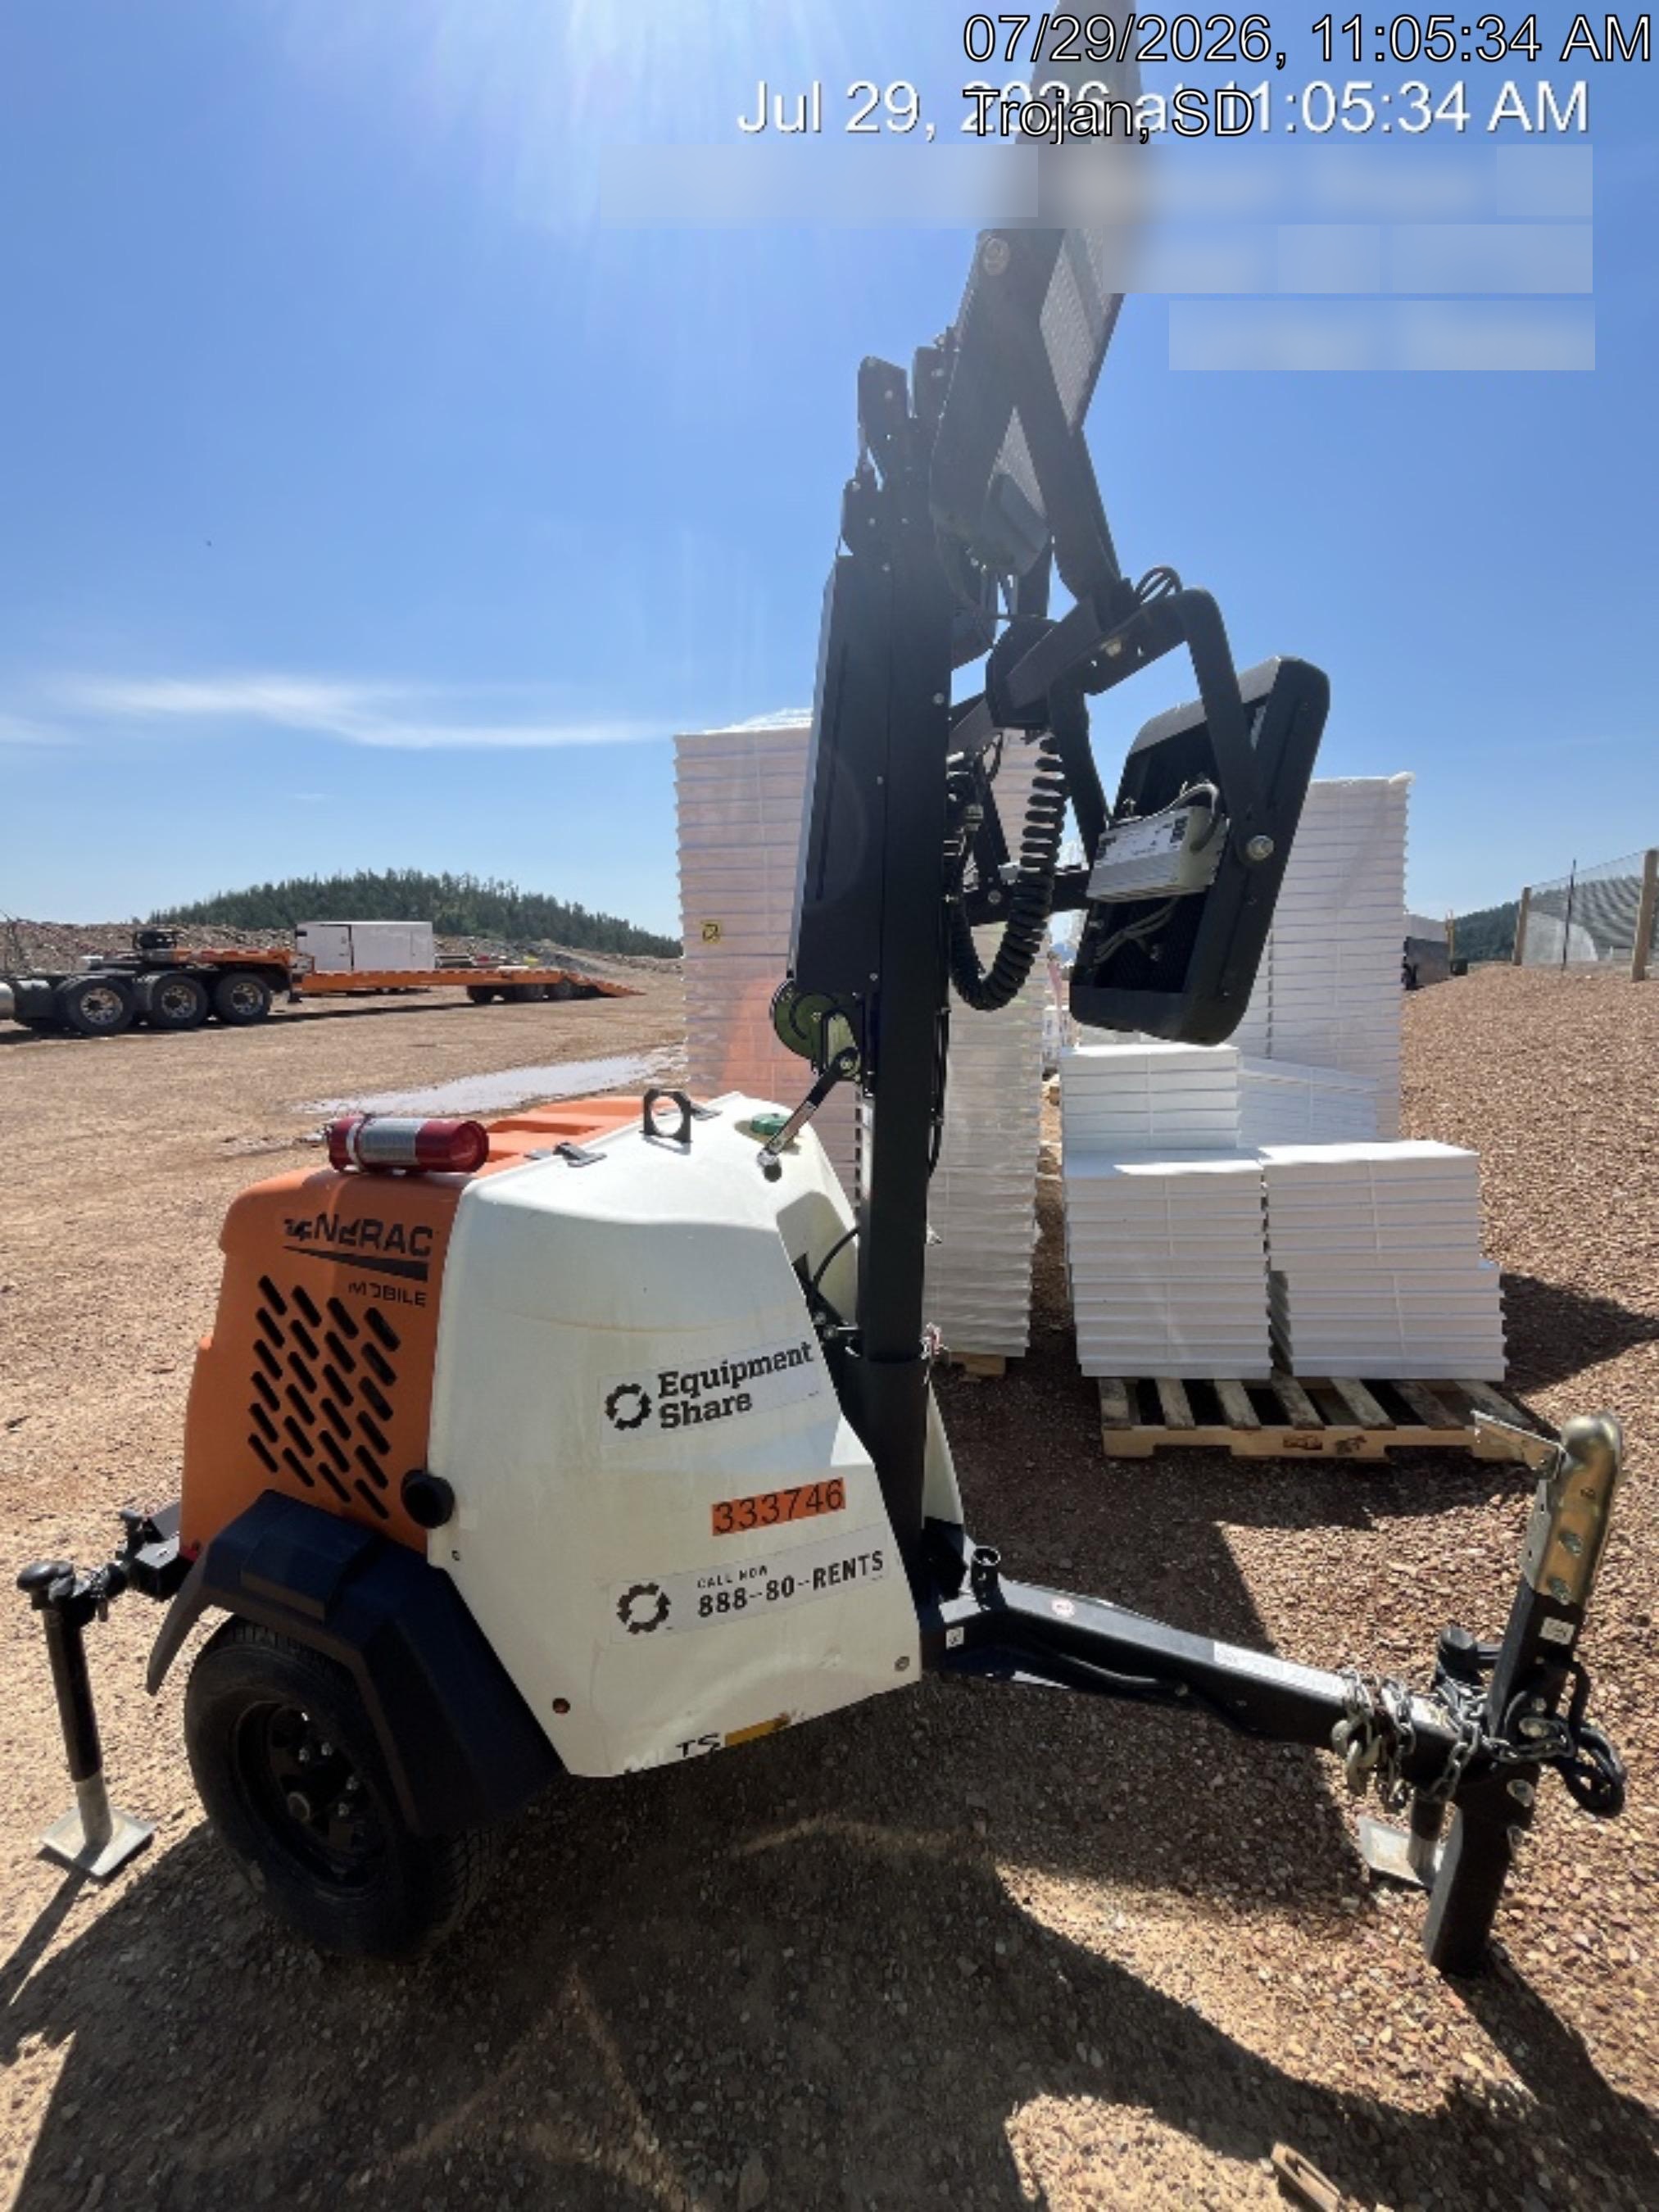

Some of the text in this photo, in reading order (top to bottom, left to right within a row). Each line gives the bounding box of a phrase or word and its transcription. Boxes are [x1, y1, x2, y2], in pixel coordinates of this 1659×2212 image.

[348, 1281, 427, 1308] MOBILE
[657, 1340, 814, 1399] Equipment
[659, 1393, 753, 1430] Share
[714, 1480, 844, 1534] 333746
